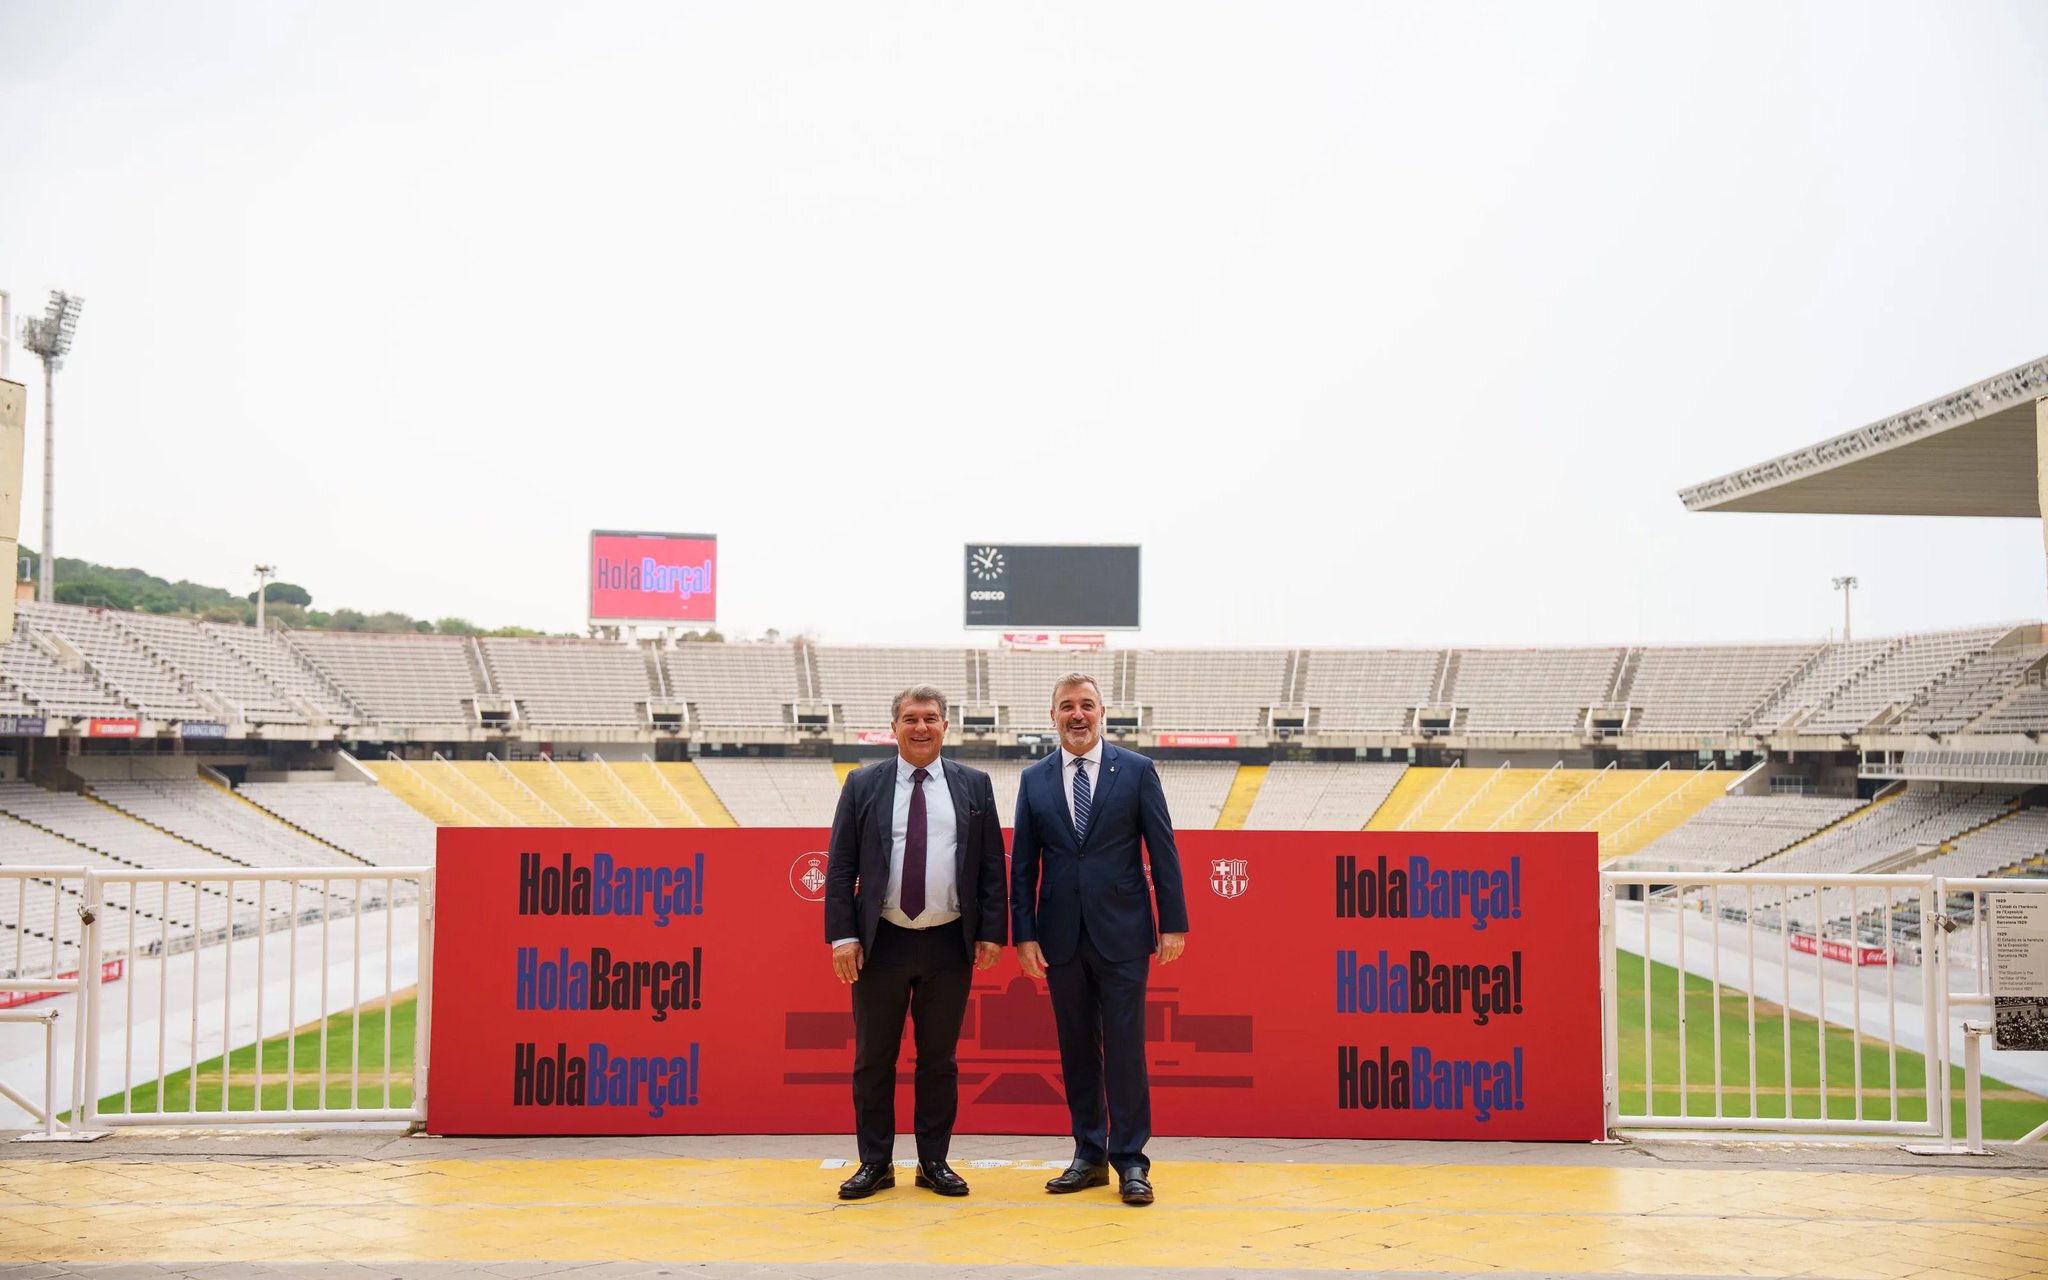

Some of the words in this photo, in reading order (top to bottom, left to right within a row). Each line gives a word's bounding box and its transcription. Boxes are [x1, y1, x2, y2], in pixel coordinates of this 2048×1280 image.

[597, 557, 712, 600] HolaBarça!
[518, 852, 705, 928] HolaBarça!
[1335, 855, 1522, 931] HolaBarça!
[515, 947, 703, 1022] HolaBarça!
[1336, 950, 1524, 1026] HolaBarça!
[512, 1042, 700, 1119] HolaBarça!
[1337, 1046, 1525, 1123] HolaBarça!
